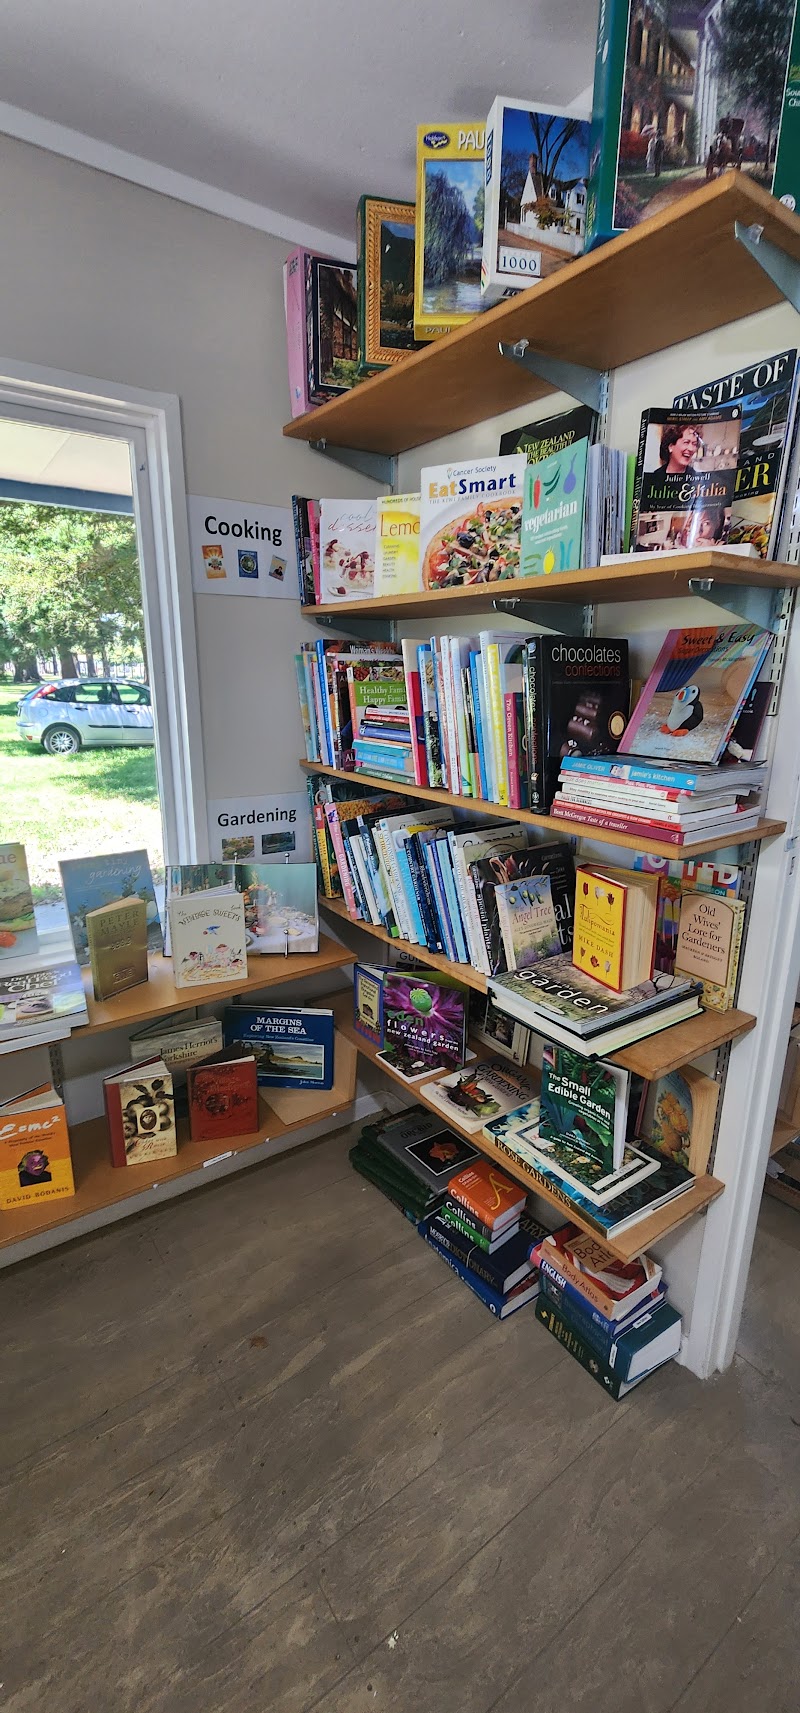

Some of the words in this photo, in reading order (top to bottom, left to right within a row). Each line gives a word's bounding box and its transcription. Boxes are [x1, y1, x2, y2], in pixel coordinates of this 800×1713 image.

[457, 130, 487, 150] PAU
[501, 255, 537, 272] 1000
[675, 374, 744, 410] TASTE
[753, 355, 789, 389] OF
[540, 430, 576, 447] ZEALAND
[453, 468, 474, 477] Cancer
[475, 465, 497, 474] Society
[686, 473, 710, 481] Powell
[734, 462, 771, 492] ER
[647, 485, 678, 499] Julie
[679, 483, 695, 502] &
[694, 482, 726, 498] Julia
[328, 519, 377, 532] desser
[381, 514, 420, 537] Lemo
[524, 500, 578, 533] vegetarian
[204, 515, 282, 547] Cooking
[682, 634, 713, 645] Sweet
[715, 633, 725, 643] &
[728, 631, 755, 645] Easy
[551, 643, 621, 663] chocolates
[565, 663, 620, 677] confections
[360, 685, 387, 696] Healthy
[389, 684, 407, 695] Fami
[363, 695, 386, 706] Happy
[387, 693, 408, 703] Famil
[587, 763, 606, 772] OLIVER
[631, 771, 651, 780] jamie's
[653, 773, 676, 782] kitchen
[217, 808, 297, 827] Gardening
[587, 815, 598, 824] Taste
[599, 818, 605, 826] of
[88, 864, 141, 885] gardening
[337, 853, 351, 886] GARDENING
[213, 908, 241, 922] SWEETS
[475, 892, 488, 922] special
[512, 906, 533, 926] Angel
[533, 905, 552, 917] Tree
[554, 893, 573, 922] al
[699, 903, 716, 917] Old
[100, 910, 140, 927] PETER
[101, 919, 139, 936] MAYLE
[579, 904, 615, 936] Tulipomania
[693, 913, 721, 931] Wives'
[481, 922, 494, 949] plants
[557, 922, 574, 946] ts
[681, 931, 726, 954] Gardeners
[688, 923, 708, 938] Lore
[709, 930, 722, 942] for
[578, 935, 595, 948] MIKE
[596, 945, 614, 958] DASH
[513, 969, 609, 1014] garden
[256, 1016, 302, 1027] MARGINS
[387, 1009, 424, 1027] eden
[250, 1024, 263, 1032] OF
[265, 1025, 286, 1033] THE
[288, 1026, 307, 1035] SEA
[387, 1019, 445, 1042] flowers
[387, 1028, 401, 1036] new
[403, 1032, 431, 1044] zealand
[433, 1040, 459, 1052] garden
[184, 1036, 218, 1050] Herriot's
[476, 1063, 530, 1100] GARDENING
[490, 1063, 531, 1091] ORGANIC
[549, 1072, 561, 1081] The
[561, 1076, 591, 1097] Small
[547, 1082, 579, 1101] Edible
[579, 1094, 612, 1120] Garden
[458, 1171, 475, 1183] Collins
[497, 1138, 522, 1167] ROSE
[521, 1159, 572, 1209] GARDENS
[6, 1193, 31, 1204] DAVID
[35, 1186, 70, 1198] BODANIS
[488, 1172, 514, 1211] A
[450, 1188, 480, 1218] Collins
[445, 1201, 477, 1229] Collins
[444, 1213, 475, 1242] Collins
[520, 1217, 547, 1240] ARY
[573, 1239, 602, 1259] Bod
[541, 1260, 567, 1289] ENGLISH
[562, 1263, 580, 1285] Body
[579, 1282, 599, 1303] Atlas
